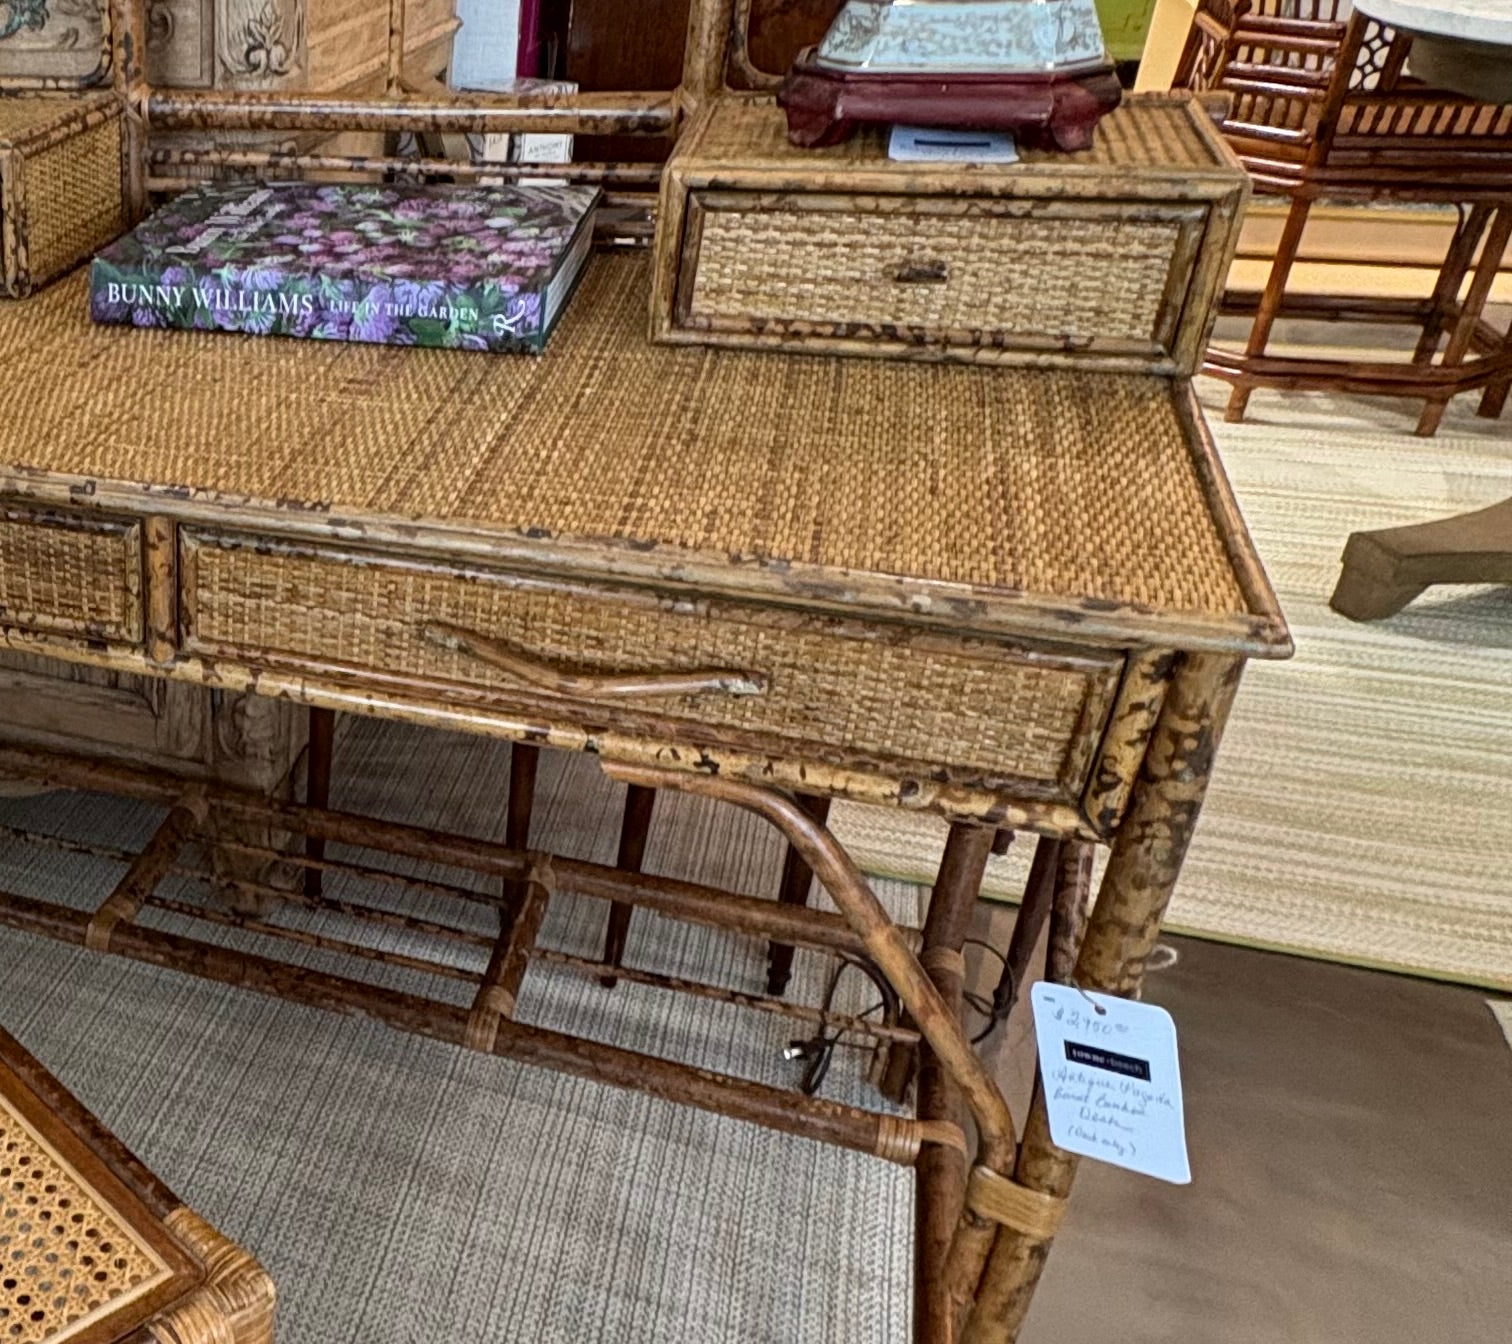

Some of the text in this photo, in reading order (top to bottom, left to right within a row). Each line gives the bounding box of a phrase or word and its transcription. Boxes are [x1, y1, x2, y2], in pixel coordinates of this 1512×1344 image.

[108, 282, 185, 307] BUNNY
[192, 287, 313, 315] WILLIAMS
[365, 302, 381, 315] IN
[386, 303, 414, 317] THE
[418, 305, 479, 322] GARDEN
